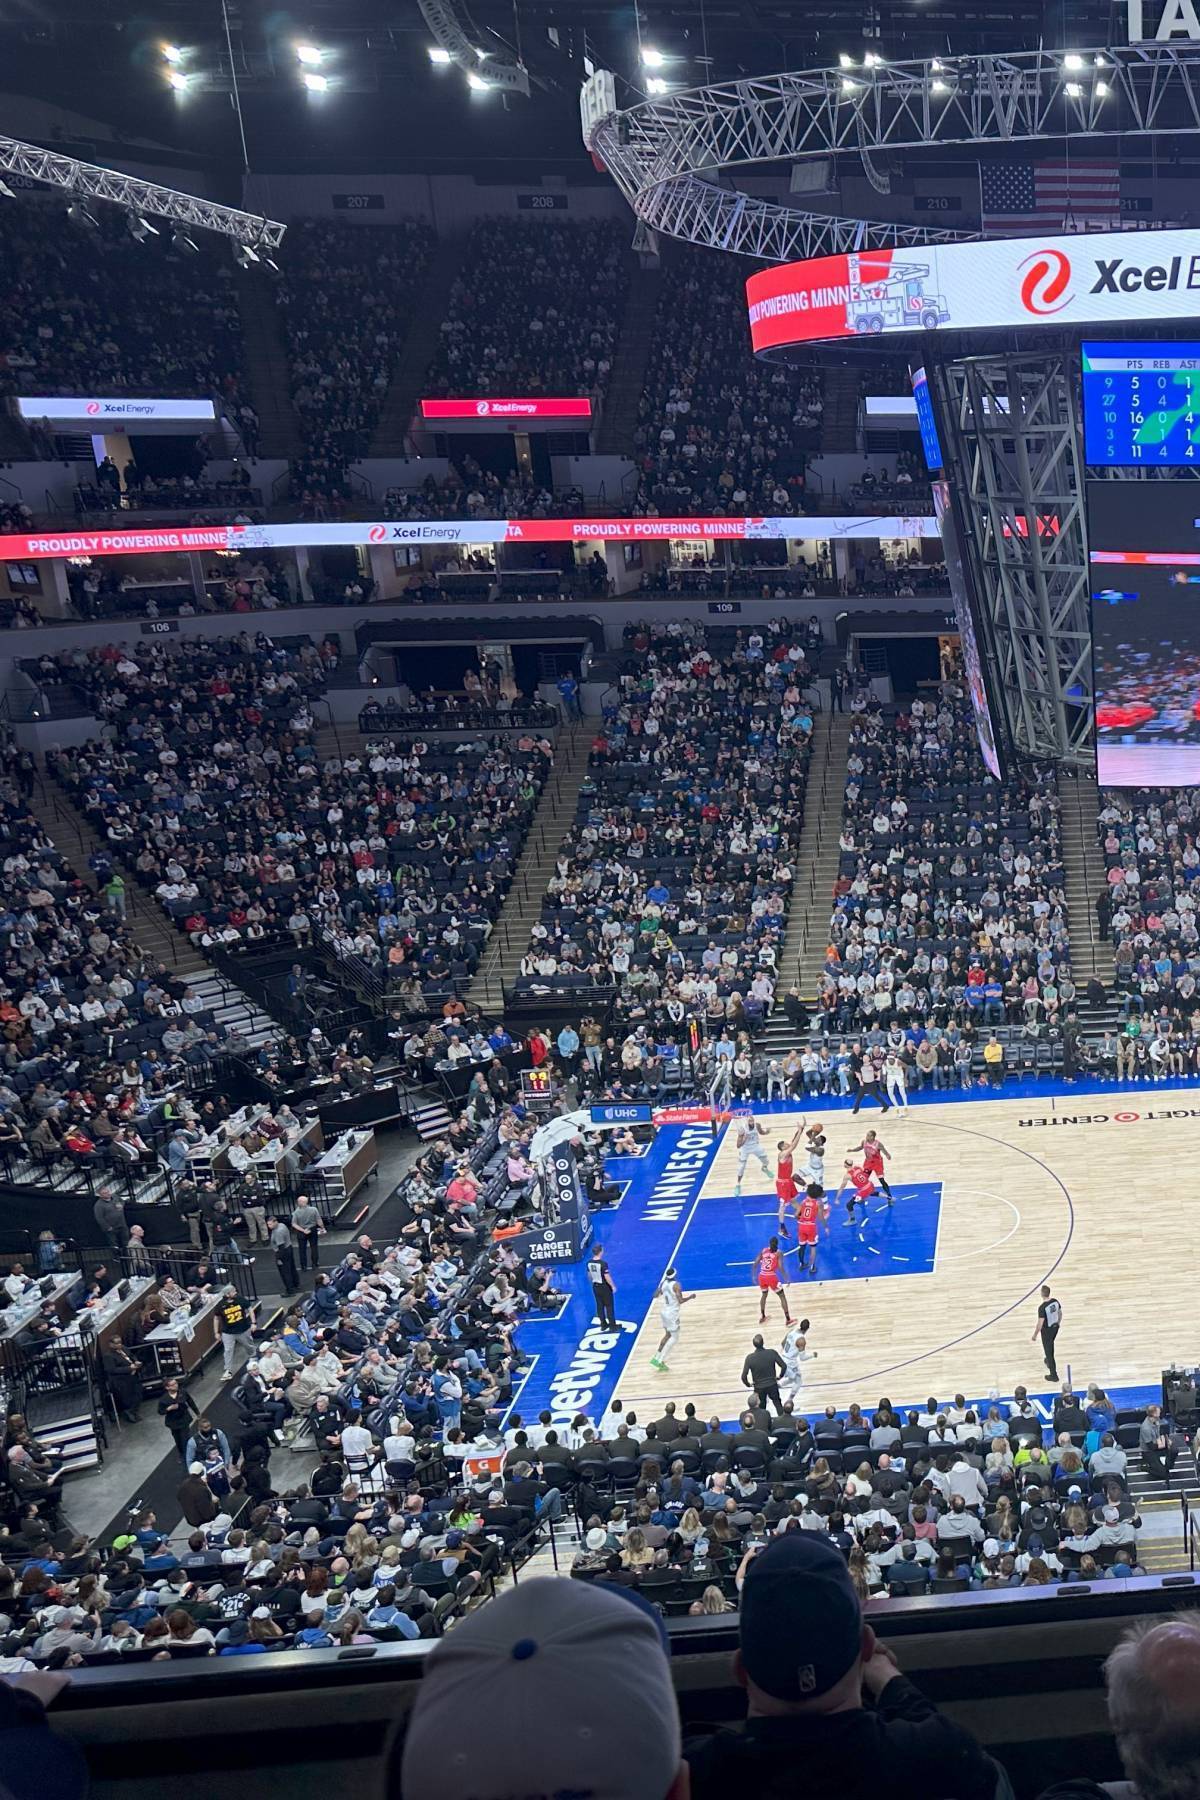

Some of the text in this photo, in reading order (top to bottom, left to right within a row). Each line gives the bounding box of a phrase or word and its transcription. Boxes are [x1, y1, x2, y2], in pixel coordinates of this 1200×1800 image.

[927, 198, 949, 209] 210
[1090, 256, 1181, 294] Xcel
[1127, 360, 1143, 369] PTS
[1153, 360, 1170, 369] REB
[1180, 360, 1197, 369] AST
[1105, 377, 1166, 389] 9 5 0
[1102, 395, 1167, 407] 27 5 4
[104, 404, 155, 415] Xcel Energy
[492, 404, 511, 412] Xcel
[1104, 412, 1194, 424] 10 16 0 4
[1106, 428, 1114, 440] 3
[1131, 429, 1140, 440] 7
[1107, 445, 1114, 457] 5
[1131, 445, 1142, 457] 11
[1159, 445, 1168, 457] 4
[1185, 445, 1194, 457] 4
[393, 526, 461, 540] Xcel Energy
[573, 524, 631, 536] PROUDLY
[634, 523, 701, 535] POWERING
[28, 538, 99, 552] PROUDLY
[102, 534, 180, 548] POWERING
[716, 603, 733, 612] 109
[150, 623, 170, 632] 106
[615, 1108, 638, 1118] UHC
[1018, 1114, 1109, 1128] CENTER
[529, 1240, 571, 1251] TARGET
[529, 1248, 573, 1260] CENTER
[478, 1459, 489, 1470] G
